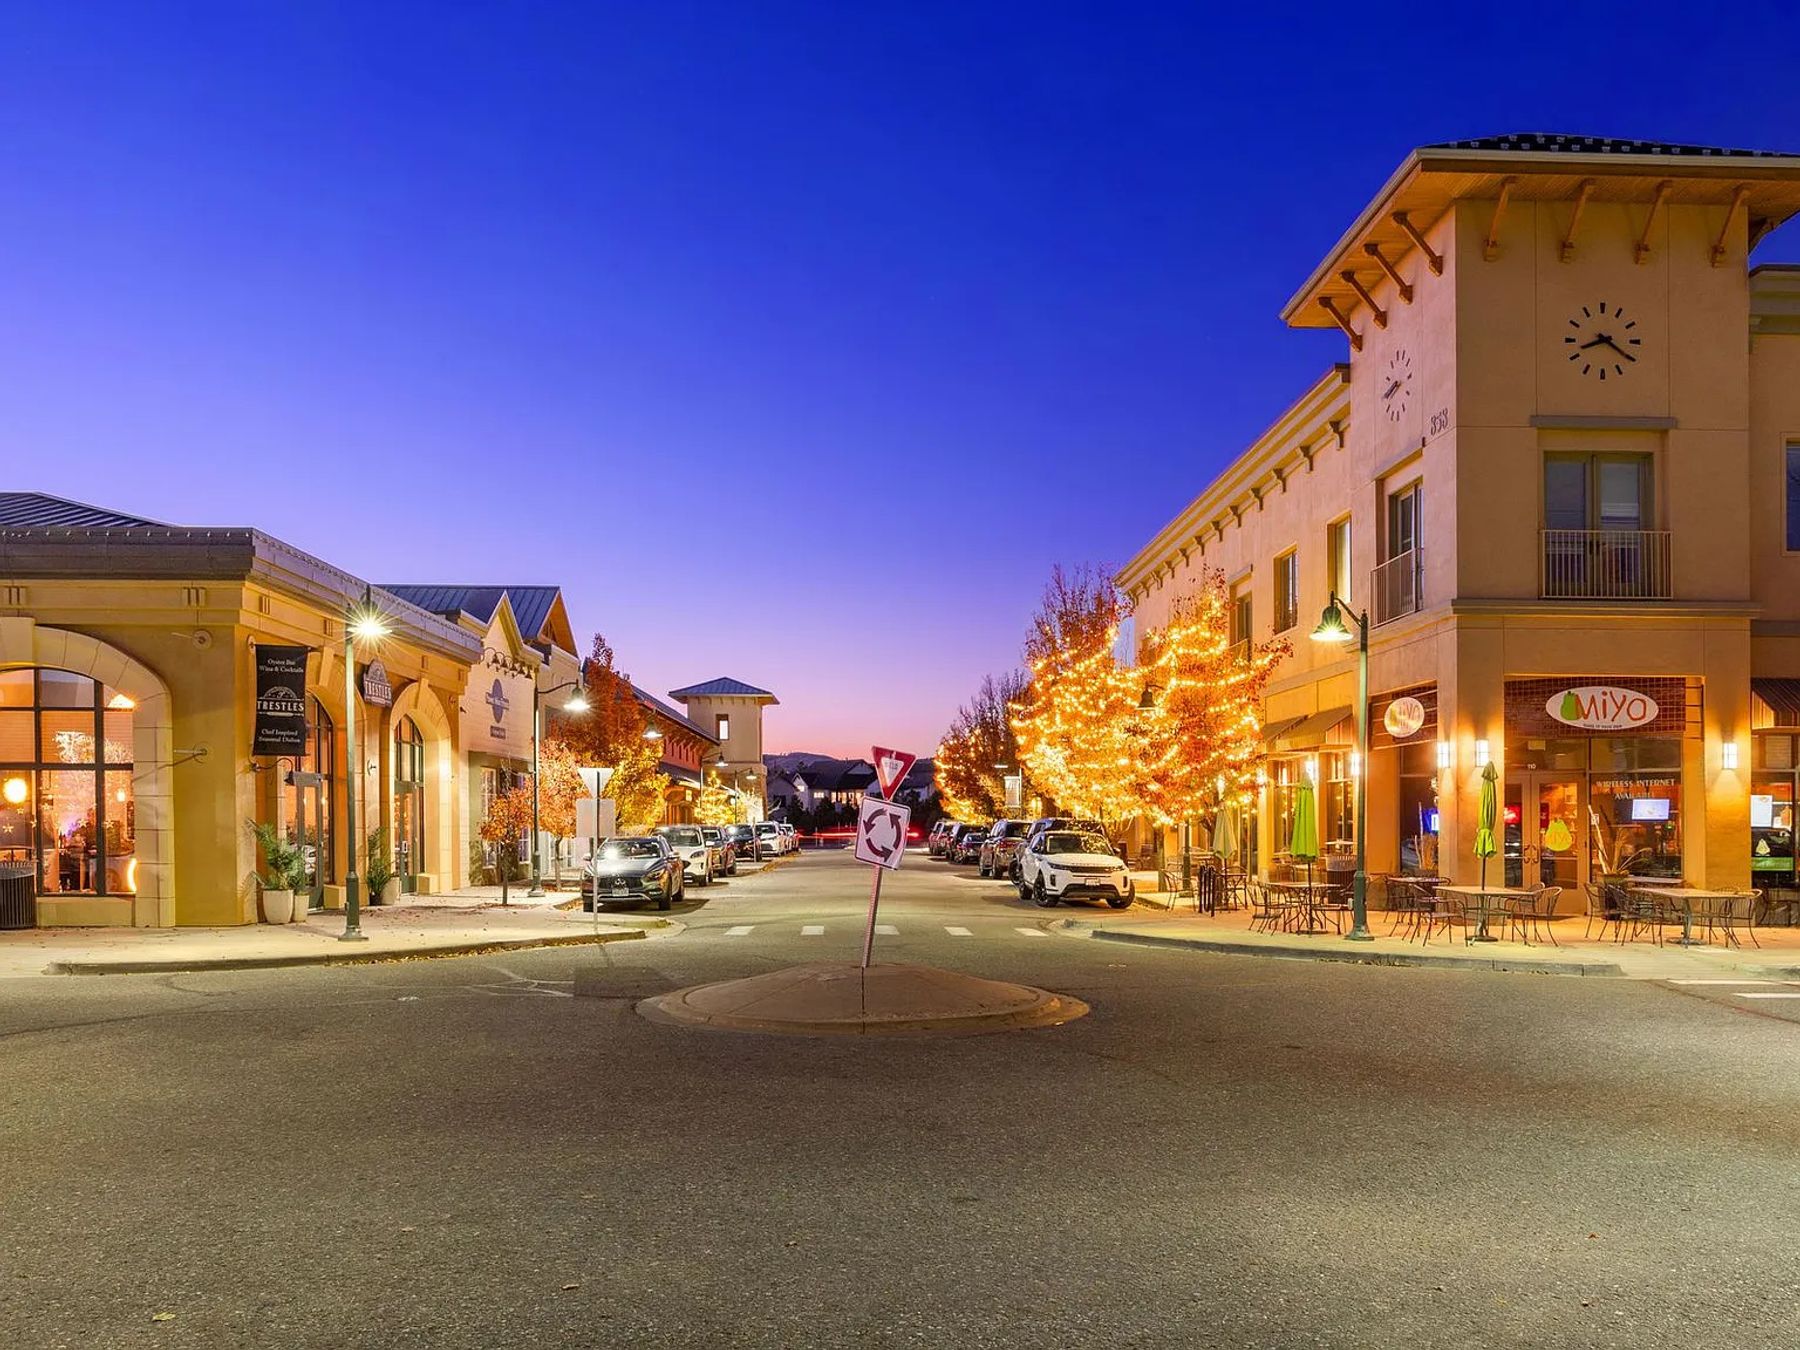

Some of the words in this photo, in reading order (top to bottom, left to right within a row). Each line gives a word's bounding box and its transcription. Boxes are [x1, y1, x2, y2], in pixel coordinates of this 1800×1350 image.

[364, 681, 392, 700] TRESTLES
[257, 701, 304, 711] TRESTLES
[1636, 778, 1676, 787] INTERNET
